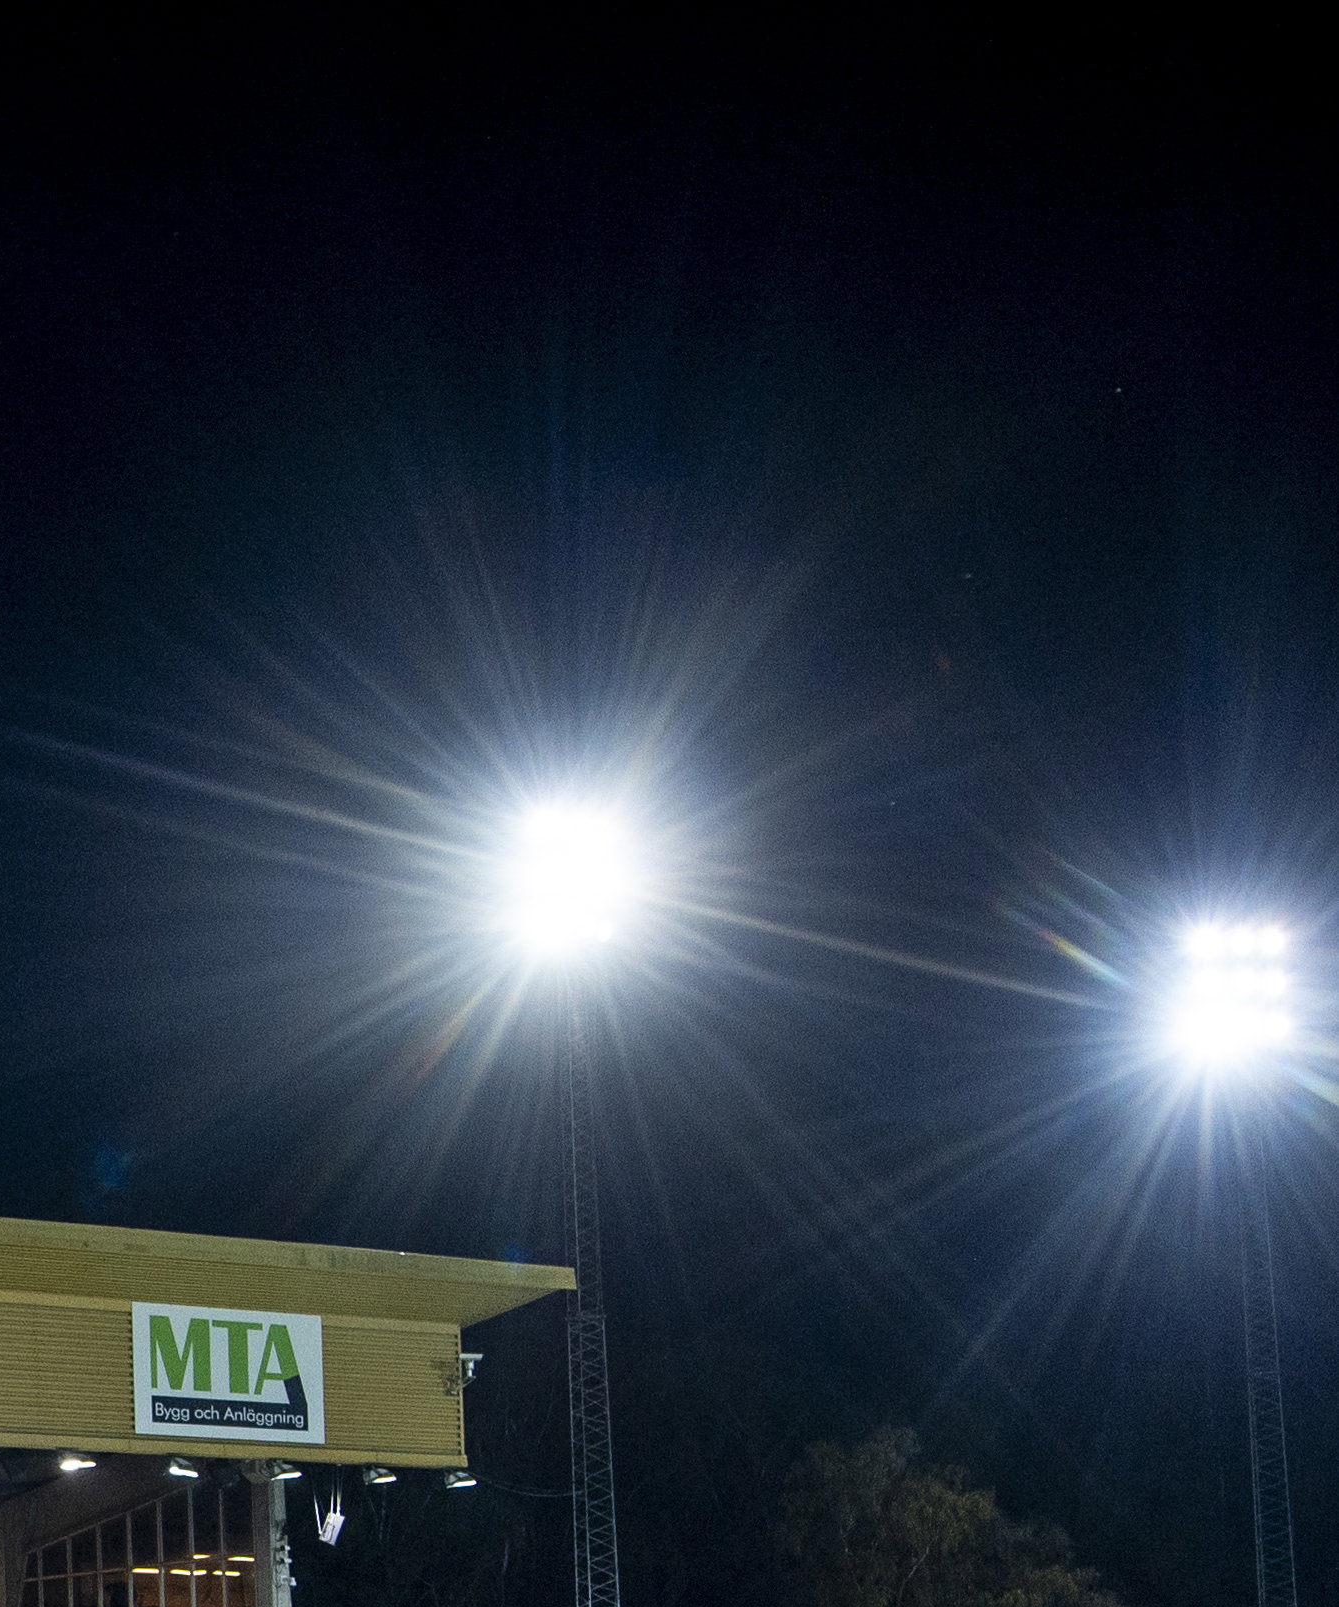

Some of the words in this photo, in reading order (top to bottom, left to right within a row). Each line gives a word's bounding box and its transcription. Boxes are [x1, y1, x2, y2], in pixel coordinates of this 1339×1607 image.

[149, 1314, 307, 1402] MTA
[155, 1402, 191, 1422] Bygg
[195, 1405, 220, 1421] och
[223, 1406, 305, 1428] Anläggning
